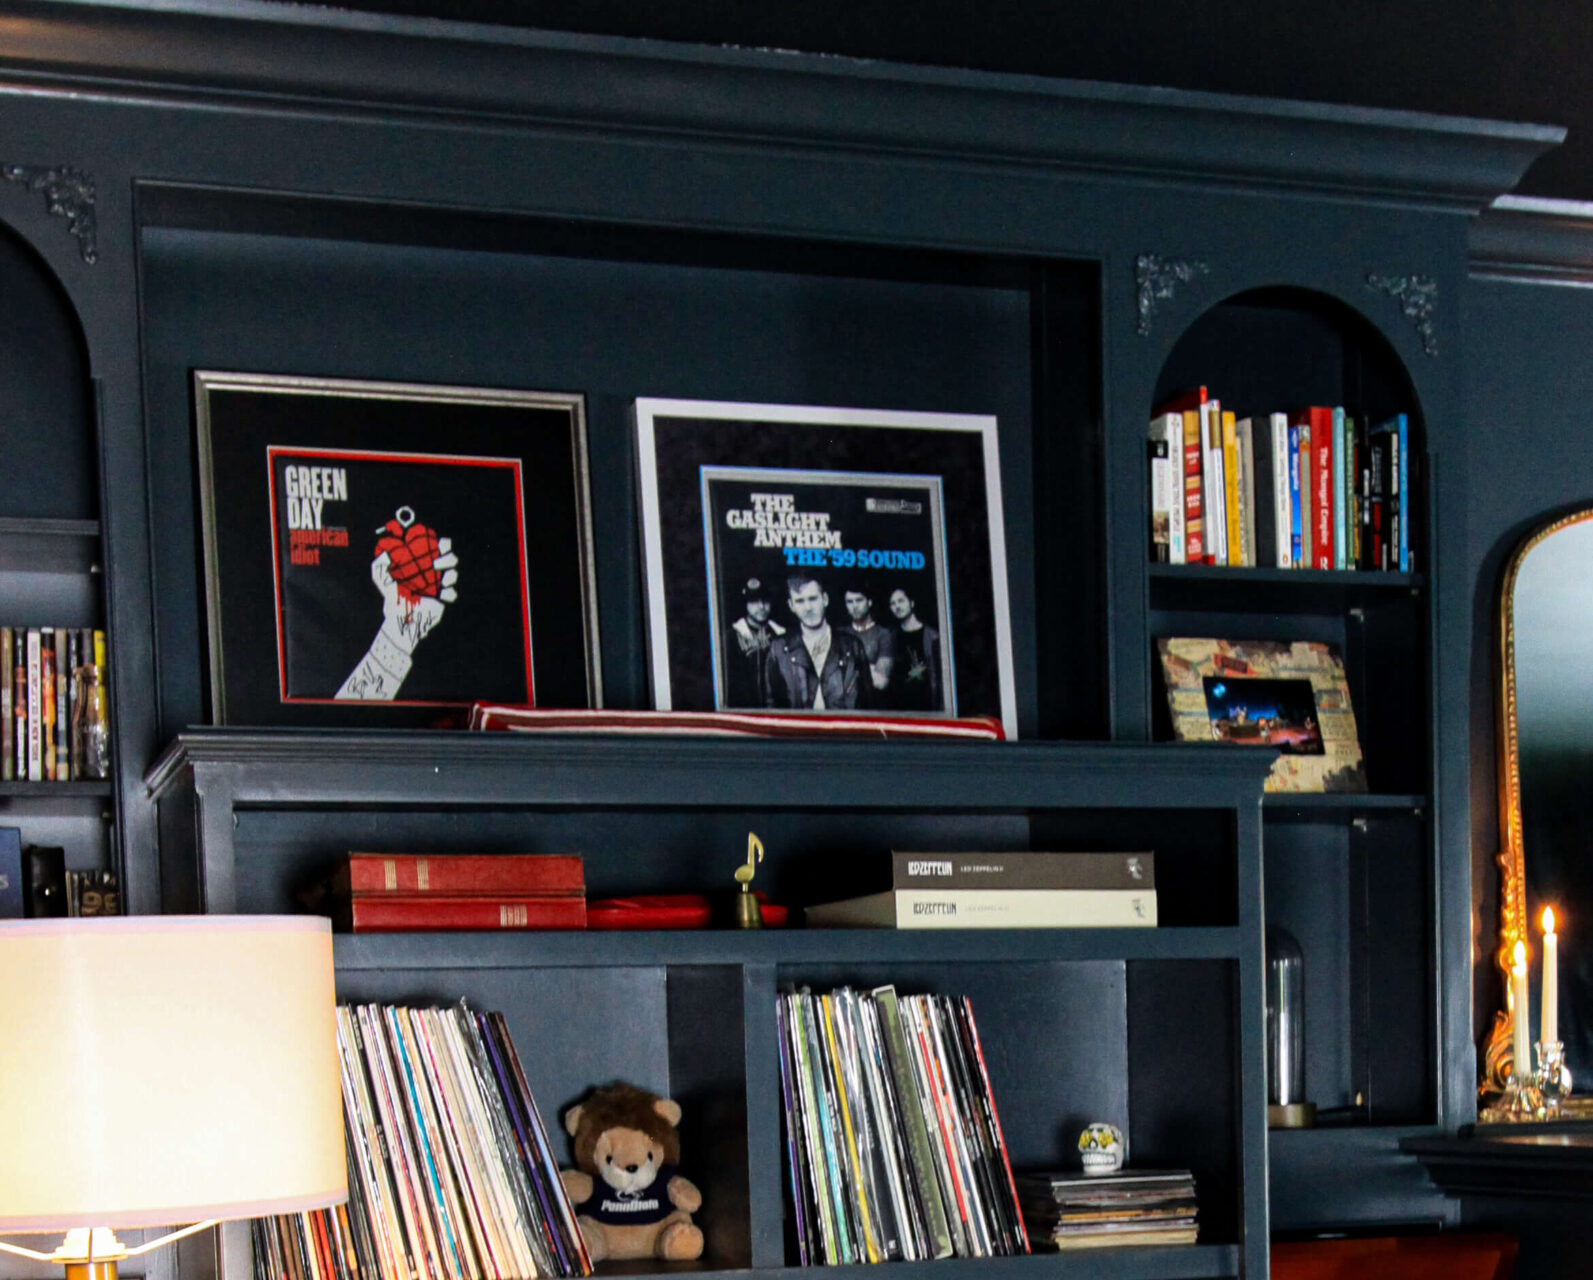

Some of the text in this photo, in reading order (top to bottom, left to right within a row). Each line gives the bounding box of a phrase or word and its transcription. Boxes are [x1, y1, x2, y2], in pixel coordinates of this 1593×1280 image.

[285, 464, 348, 501] GREEN
[287, 496, 323, 530] DAY
[750, 493, 795, 513] THE
[726, 509, 830, 532] GASLIGHT
[289, 525, 349, 547] american
[754, 529, 842, 549] ANTHEM
[291, 543, 320, 565] idiot
[783, 547, 828, 567] THE
[857, 550, 926, 570] SOUND
